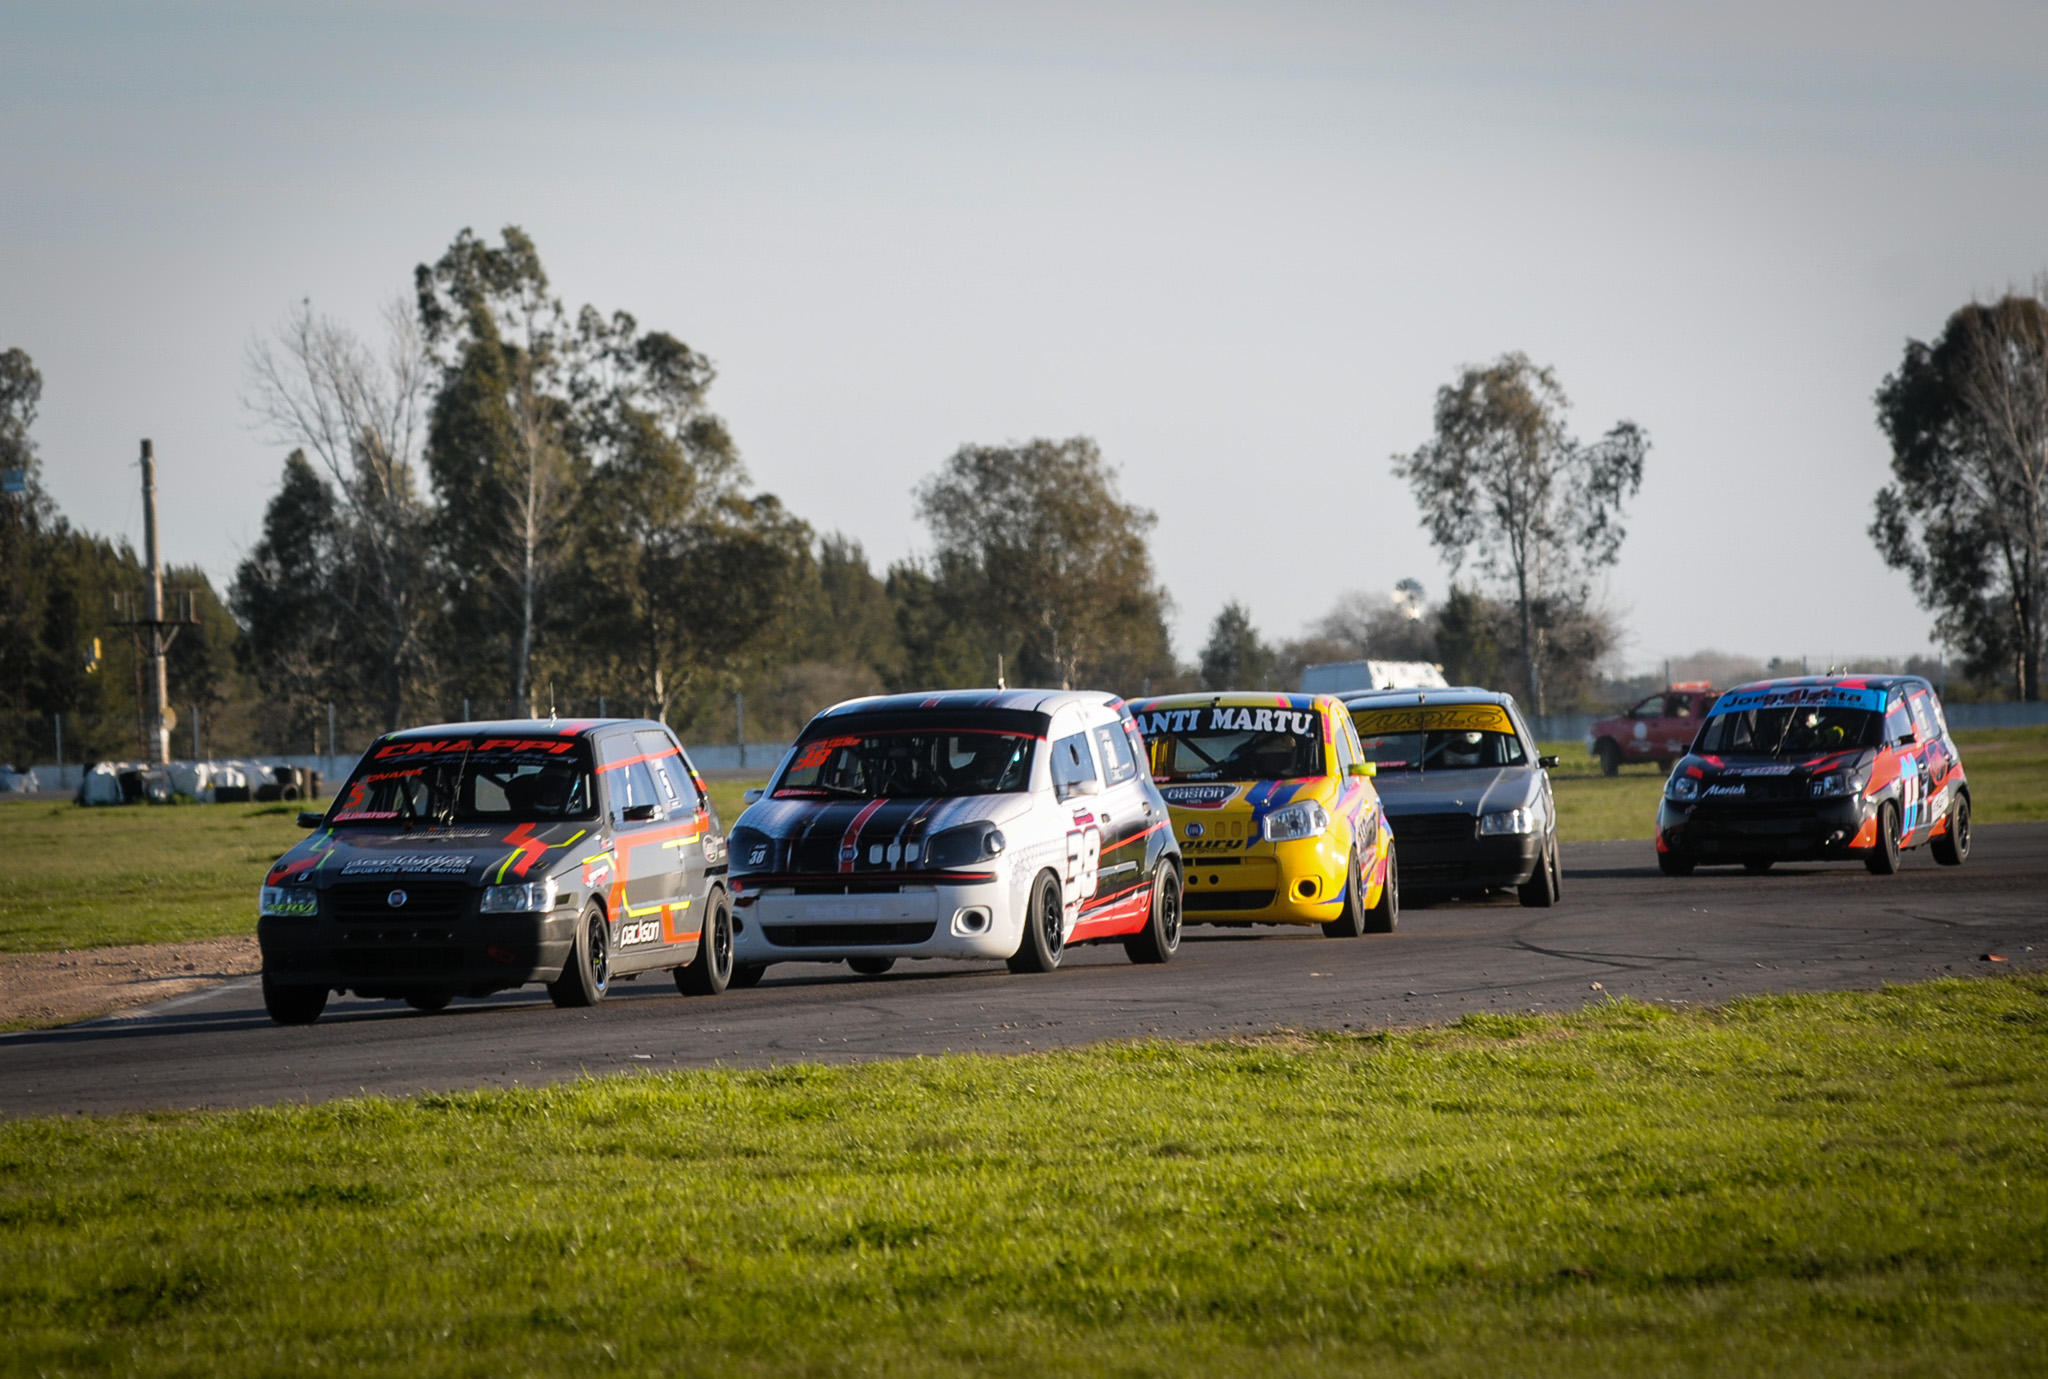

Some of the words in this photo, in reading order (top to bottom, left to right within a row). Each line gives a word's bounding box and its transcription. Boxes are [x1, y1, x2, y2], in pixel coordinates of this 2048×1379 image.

[1137, 709, 1201, 735] ANTI
[1209, 708, 1313, 735] MARTU
[373, 739, 576, 759] CNAPPI
[790, 749, 833, 772] 38
[343, 785, 367, 809] 5
[1180, 839, 1244, 850] oury
[748, 849, 766, 865] 38
[1065, 827, 1102, 906] 38
